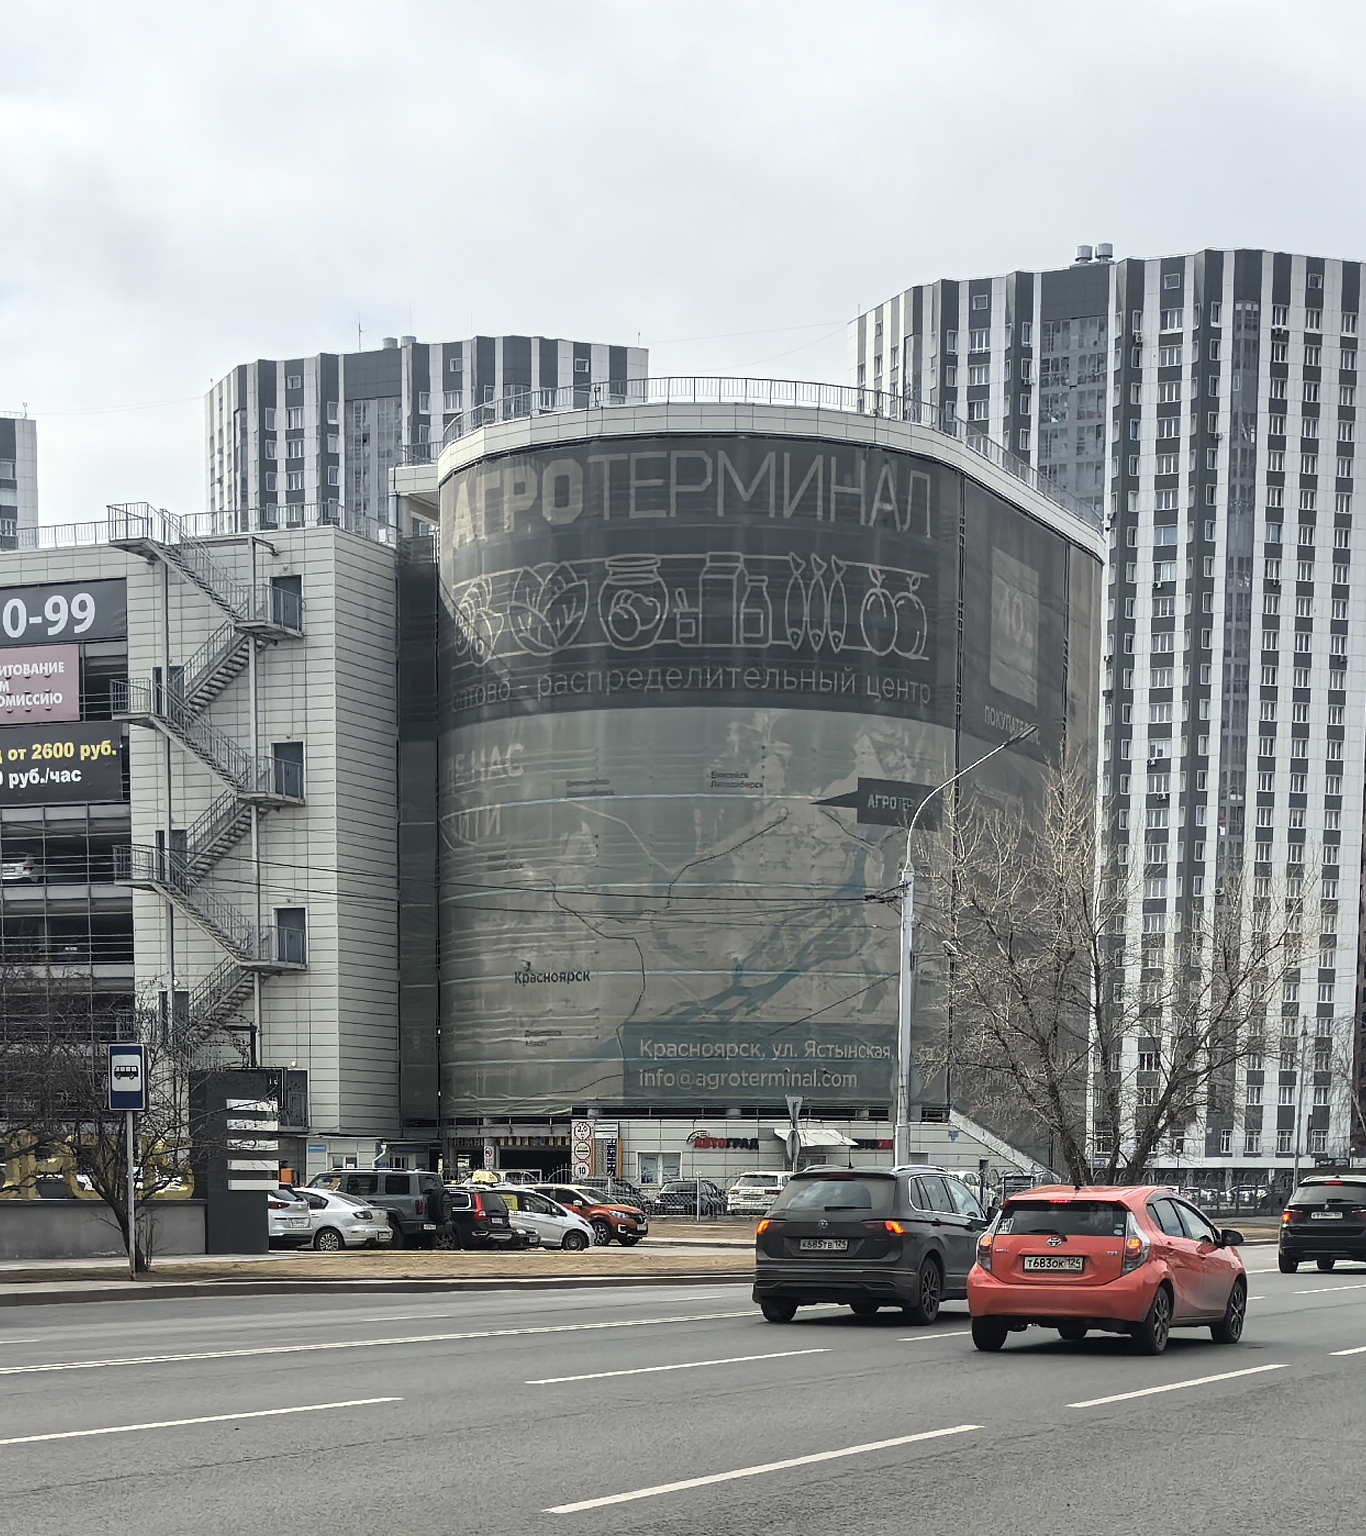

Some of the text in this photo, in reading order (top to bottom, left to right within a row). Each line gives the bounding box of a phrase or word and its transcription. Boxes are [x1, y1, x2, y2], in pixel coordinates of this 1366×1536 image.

[452, 450, 932, 549] АГРОТЕРМИНАЛ
[537, 667, 856, 700] распределительный
[866, 675, 931, 705] центр
[8, 748, 26, 760] от
[31, 742, 74, 760] 2600
[80, 740, 117, 761] руб.
[8, 768, 82, 789] руб./час
[514, 970, 591, 987] Красноярск
[639, 1039, 765, 1060] Красноярск,
[772, 1042, 797, 1060] ул.
[805, 1040, 895, 1060] Ястынская,
[639, 1068, 859, 1090] info@agroterminal.com
